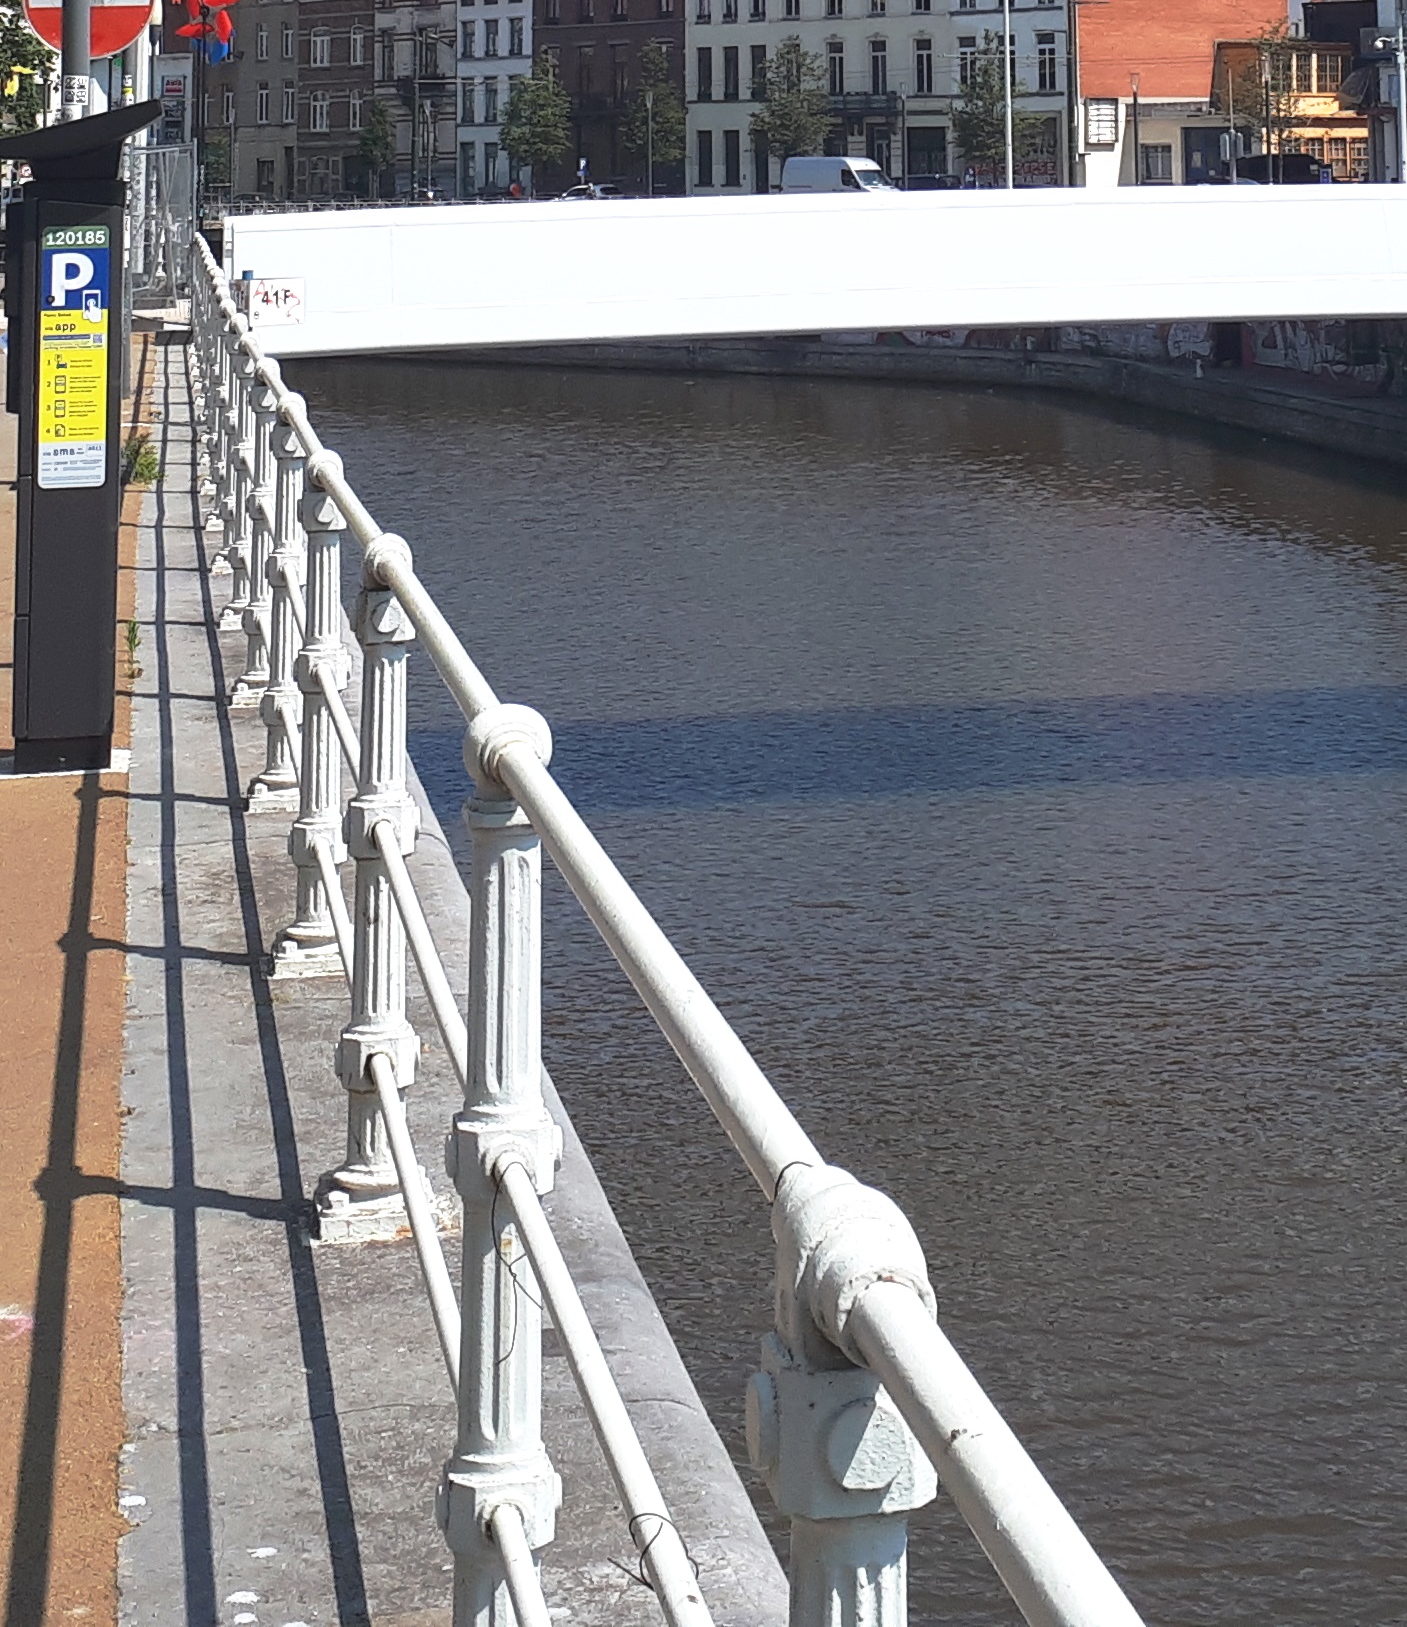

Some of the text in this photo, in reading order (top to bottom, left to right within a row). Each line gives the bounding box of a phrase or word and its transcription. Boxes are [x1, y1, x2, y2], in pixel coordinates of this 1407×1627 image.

[46, 231, 106, 246] 120185
[51, 252, 94, 307] P
[55, 323, 76, 333] app
